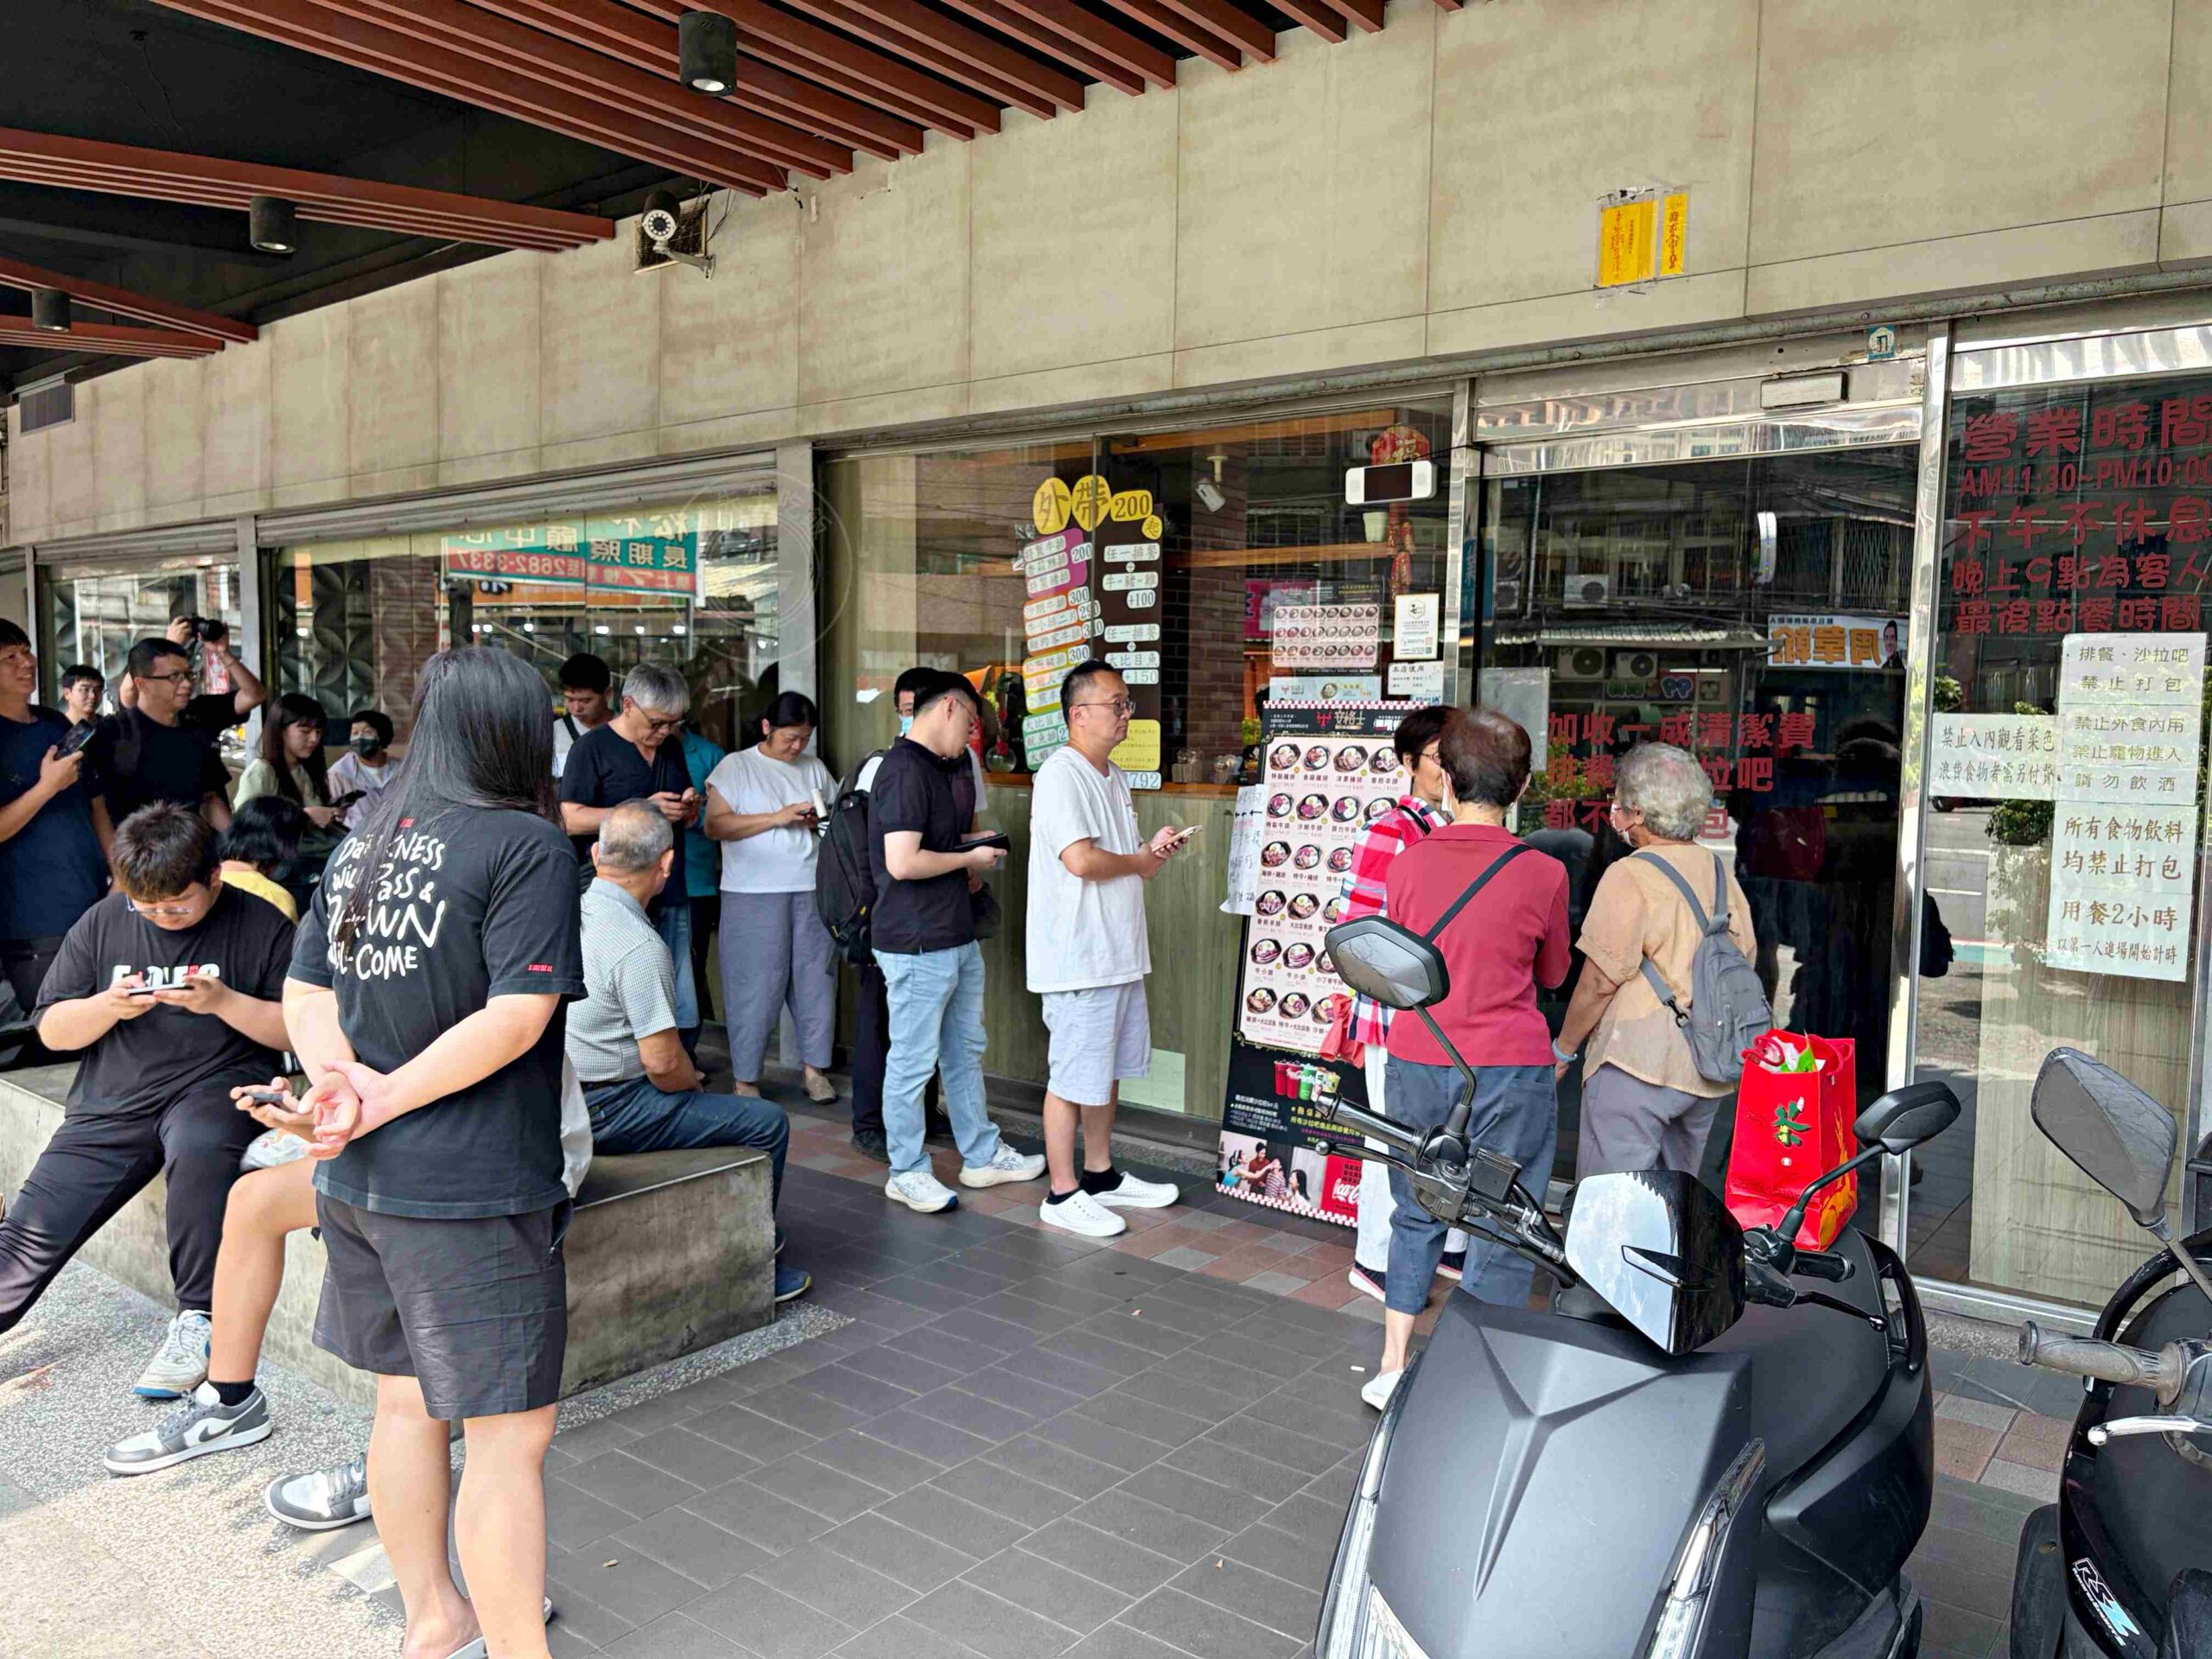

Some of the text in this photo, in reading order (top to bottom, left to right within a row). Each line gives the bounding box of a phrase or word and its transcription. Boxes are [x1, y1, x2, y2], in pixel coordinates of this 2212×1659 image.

[1963, 396, 2212, 461] 營業時間
[1115, 493, 1150, 518] 200
[1955, 496, 2212, 554] 下午不休息
[1072, 543, 1092, 563] 200
[1952, 551, 2209, 594] 晚上9點為客人
[1070, 588, 1089, 605] 300
[1955, 594, 2201, 636] 最後點餐時間
[1084, 620, 1103, 638] 30
[1069, 645, 1089, 663] 300
[2078, 646, 2189, 663] 排餐、沙拉吧
[2081, 675, 2182, 692] 禁止打包
[1548, 711, 1815, 749] 加收一成清潔費
[2075, 715, 2184, 733] 禁止外食內用
[1942, 725, 2055, 753] 禁止入內觀看菜色
[2073, 745, 2182, 762] 禁止寵物進入
[1126, 773, 1159, 788] 792
[2075, 772, 2176, 792] 請勿飲酒
[2063, 816, 2184, 844] 所有食物飲料
[2062, 849, 2182, 880] 均禁止打包
[419, 881, 435, 904] &
[2062, 899, 2178, 932] 用餐2小時
[356, 943, 418, 981] COME
[2057, 936, 2178, 965] 以第一人進場開始計時
